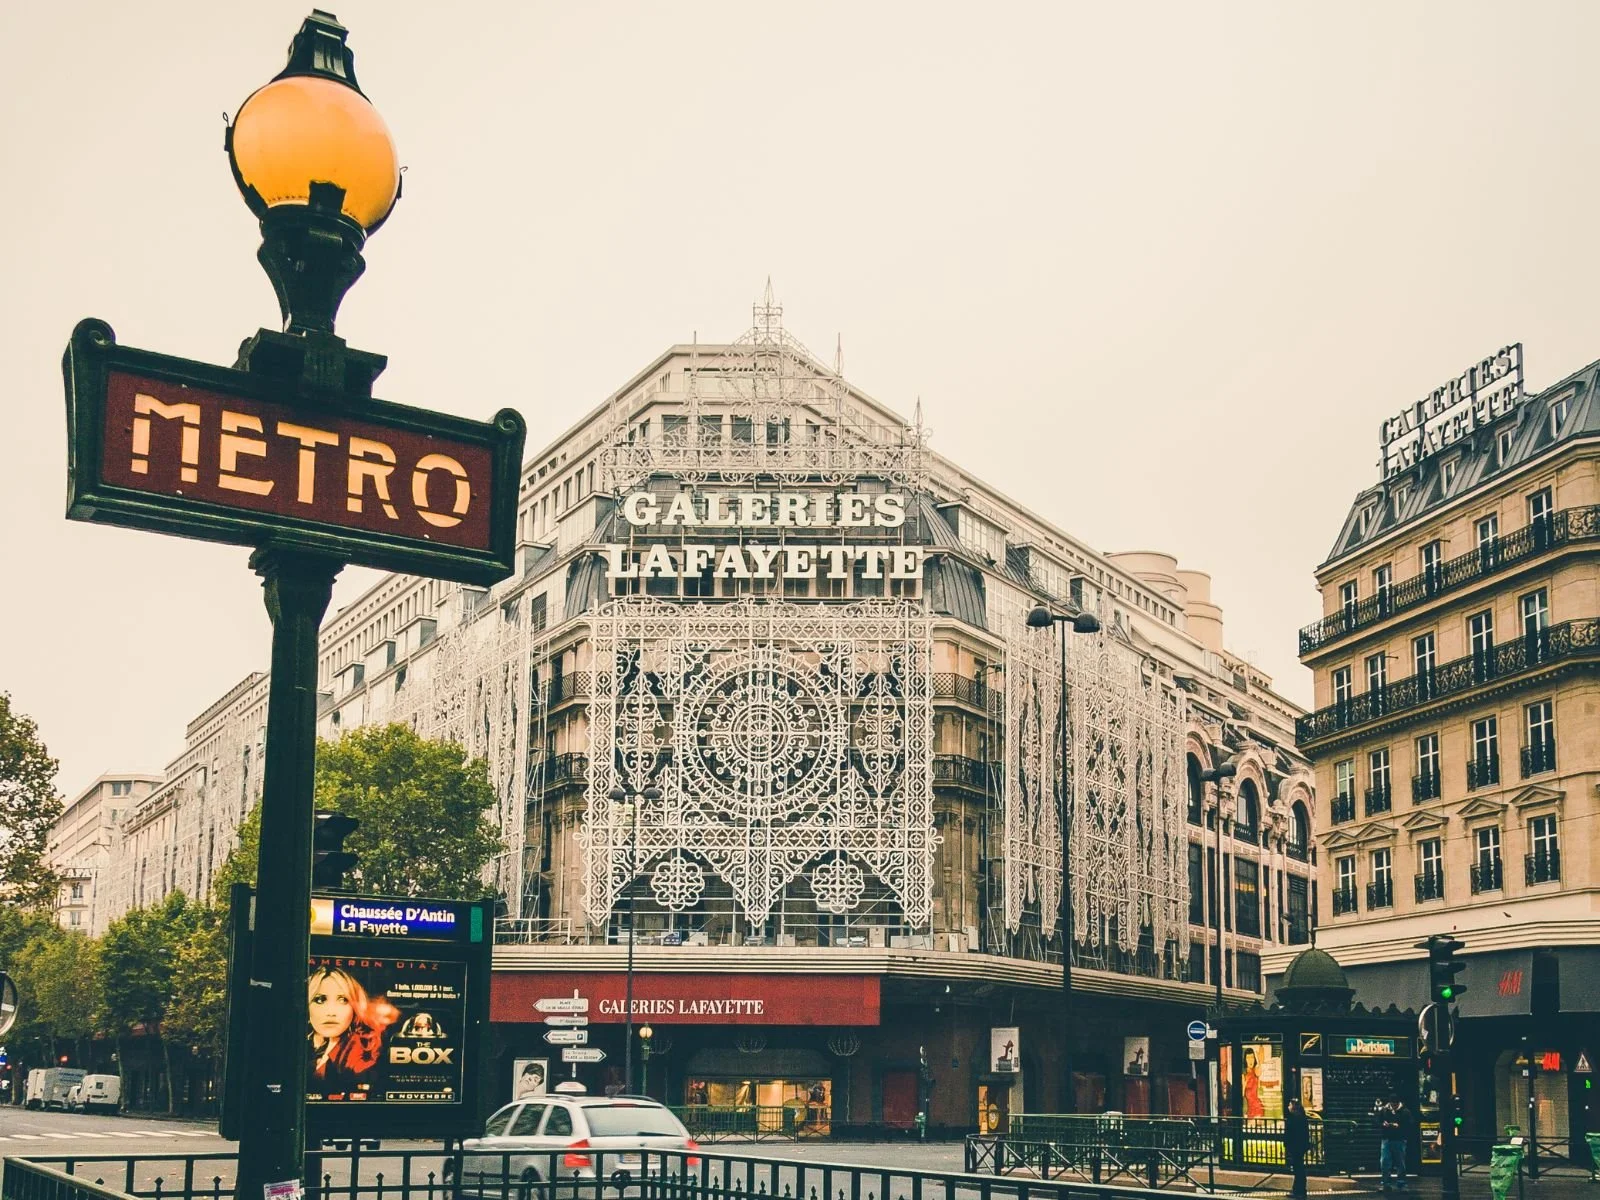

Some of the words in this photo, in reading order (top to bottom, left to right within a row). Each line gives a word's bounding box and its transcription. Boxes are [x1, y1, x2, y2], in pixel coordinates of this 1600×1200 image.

[1376, 383, 1517, 483] LAFAYETTE
[131, 393, 470, 528] METRO
[624, 491, 906, 527] GALERIES
[605, 544, 924, 579] LAFAYETTE
[341, 904, 403, 920] Chaussée
[405, 908, 455, 923] D'Antin
[341, 920, 356, 932] La
[360, 921, 408, 936] Fayette
[309, 959, 383, 968] AMERON
[396, 962, 440, 970] DIAZ
[599, 999, 675, 1014] GALERIES
[679, 999, 764, 1015] LAFAYETTE
[390, 1046, 454, 1064] BOX
